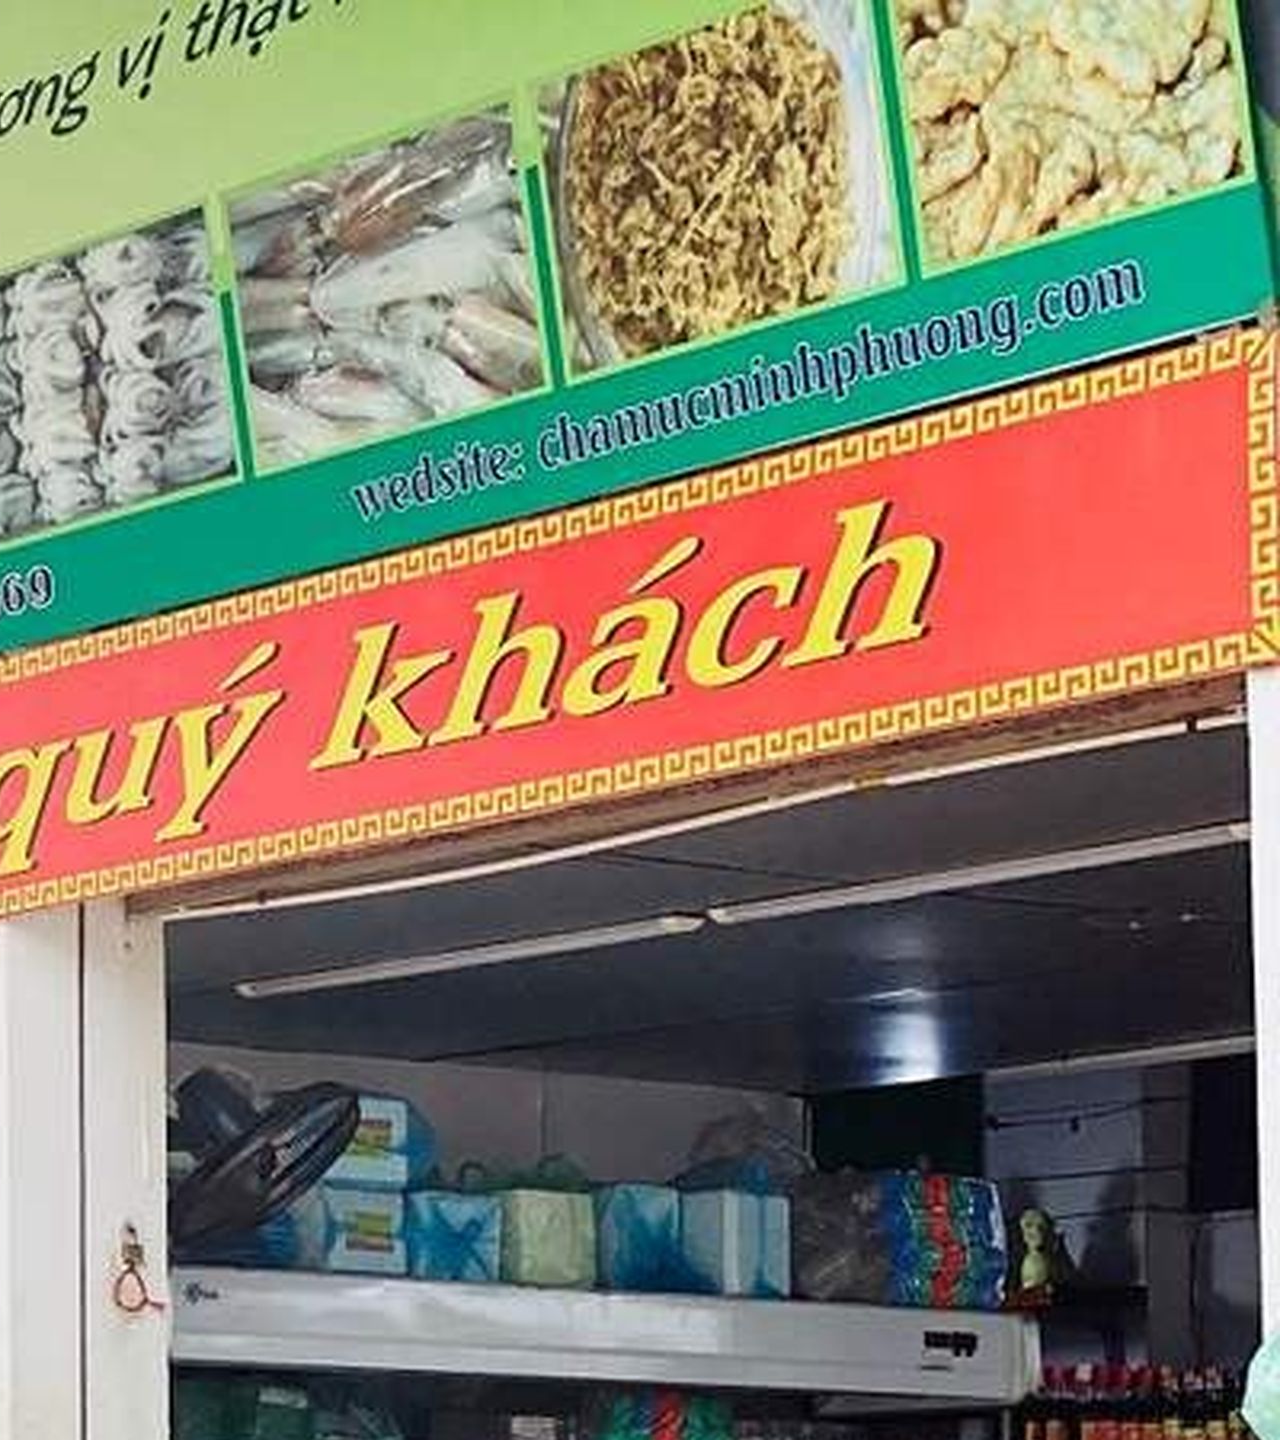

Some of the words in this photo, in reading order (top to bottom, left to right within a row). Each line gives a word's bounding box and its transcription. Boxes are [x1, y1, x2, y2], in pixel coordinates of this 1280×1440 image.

[118, 9, 171, 100] vị
[537, 257, 1144, 470] chamucminhphuong.com
[308, 498, 944, 770] khách
